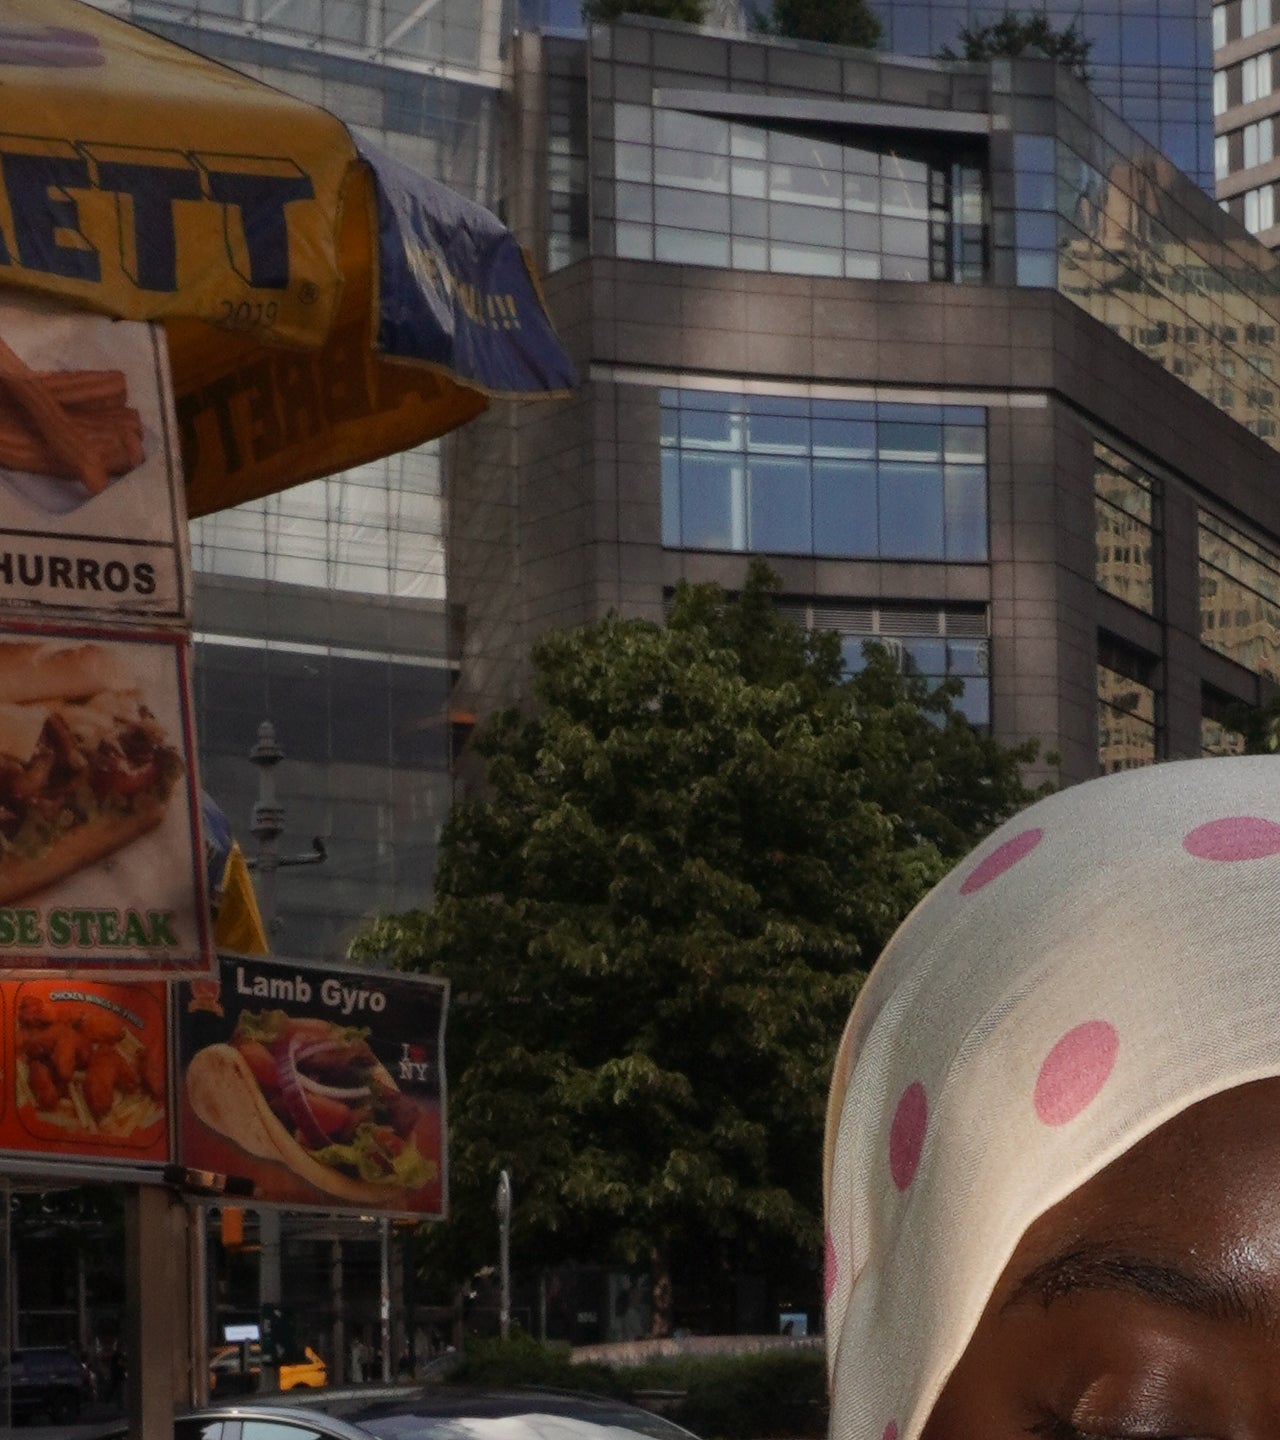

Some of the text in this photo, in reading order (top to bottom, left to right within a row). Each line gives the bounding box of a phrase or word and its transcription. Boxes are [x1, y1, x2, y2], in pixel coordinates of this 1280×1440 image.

[47, 910, 179, 950] STEAK
[236, 966, 387, 1015] Lamb Gyro
[399, 1060, 429, 1081] NY
